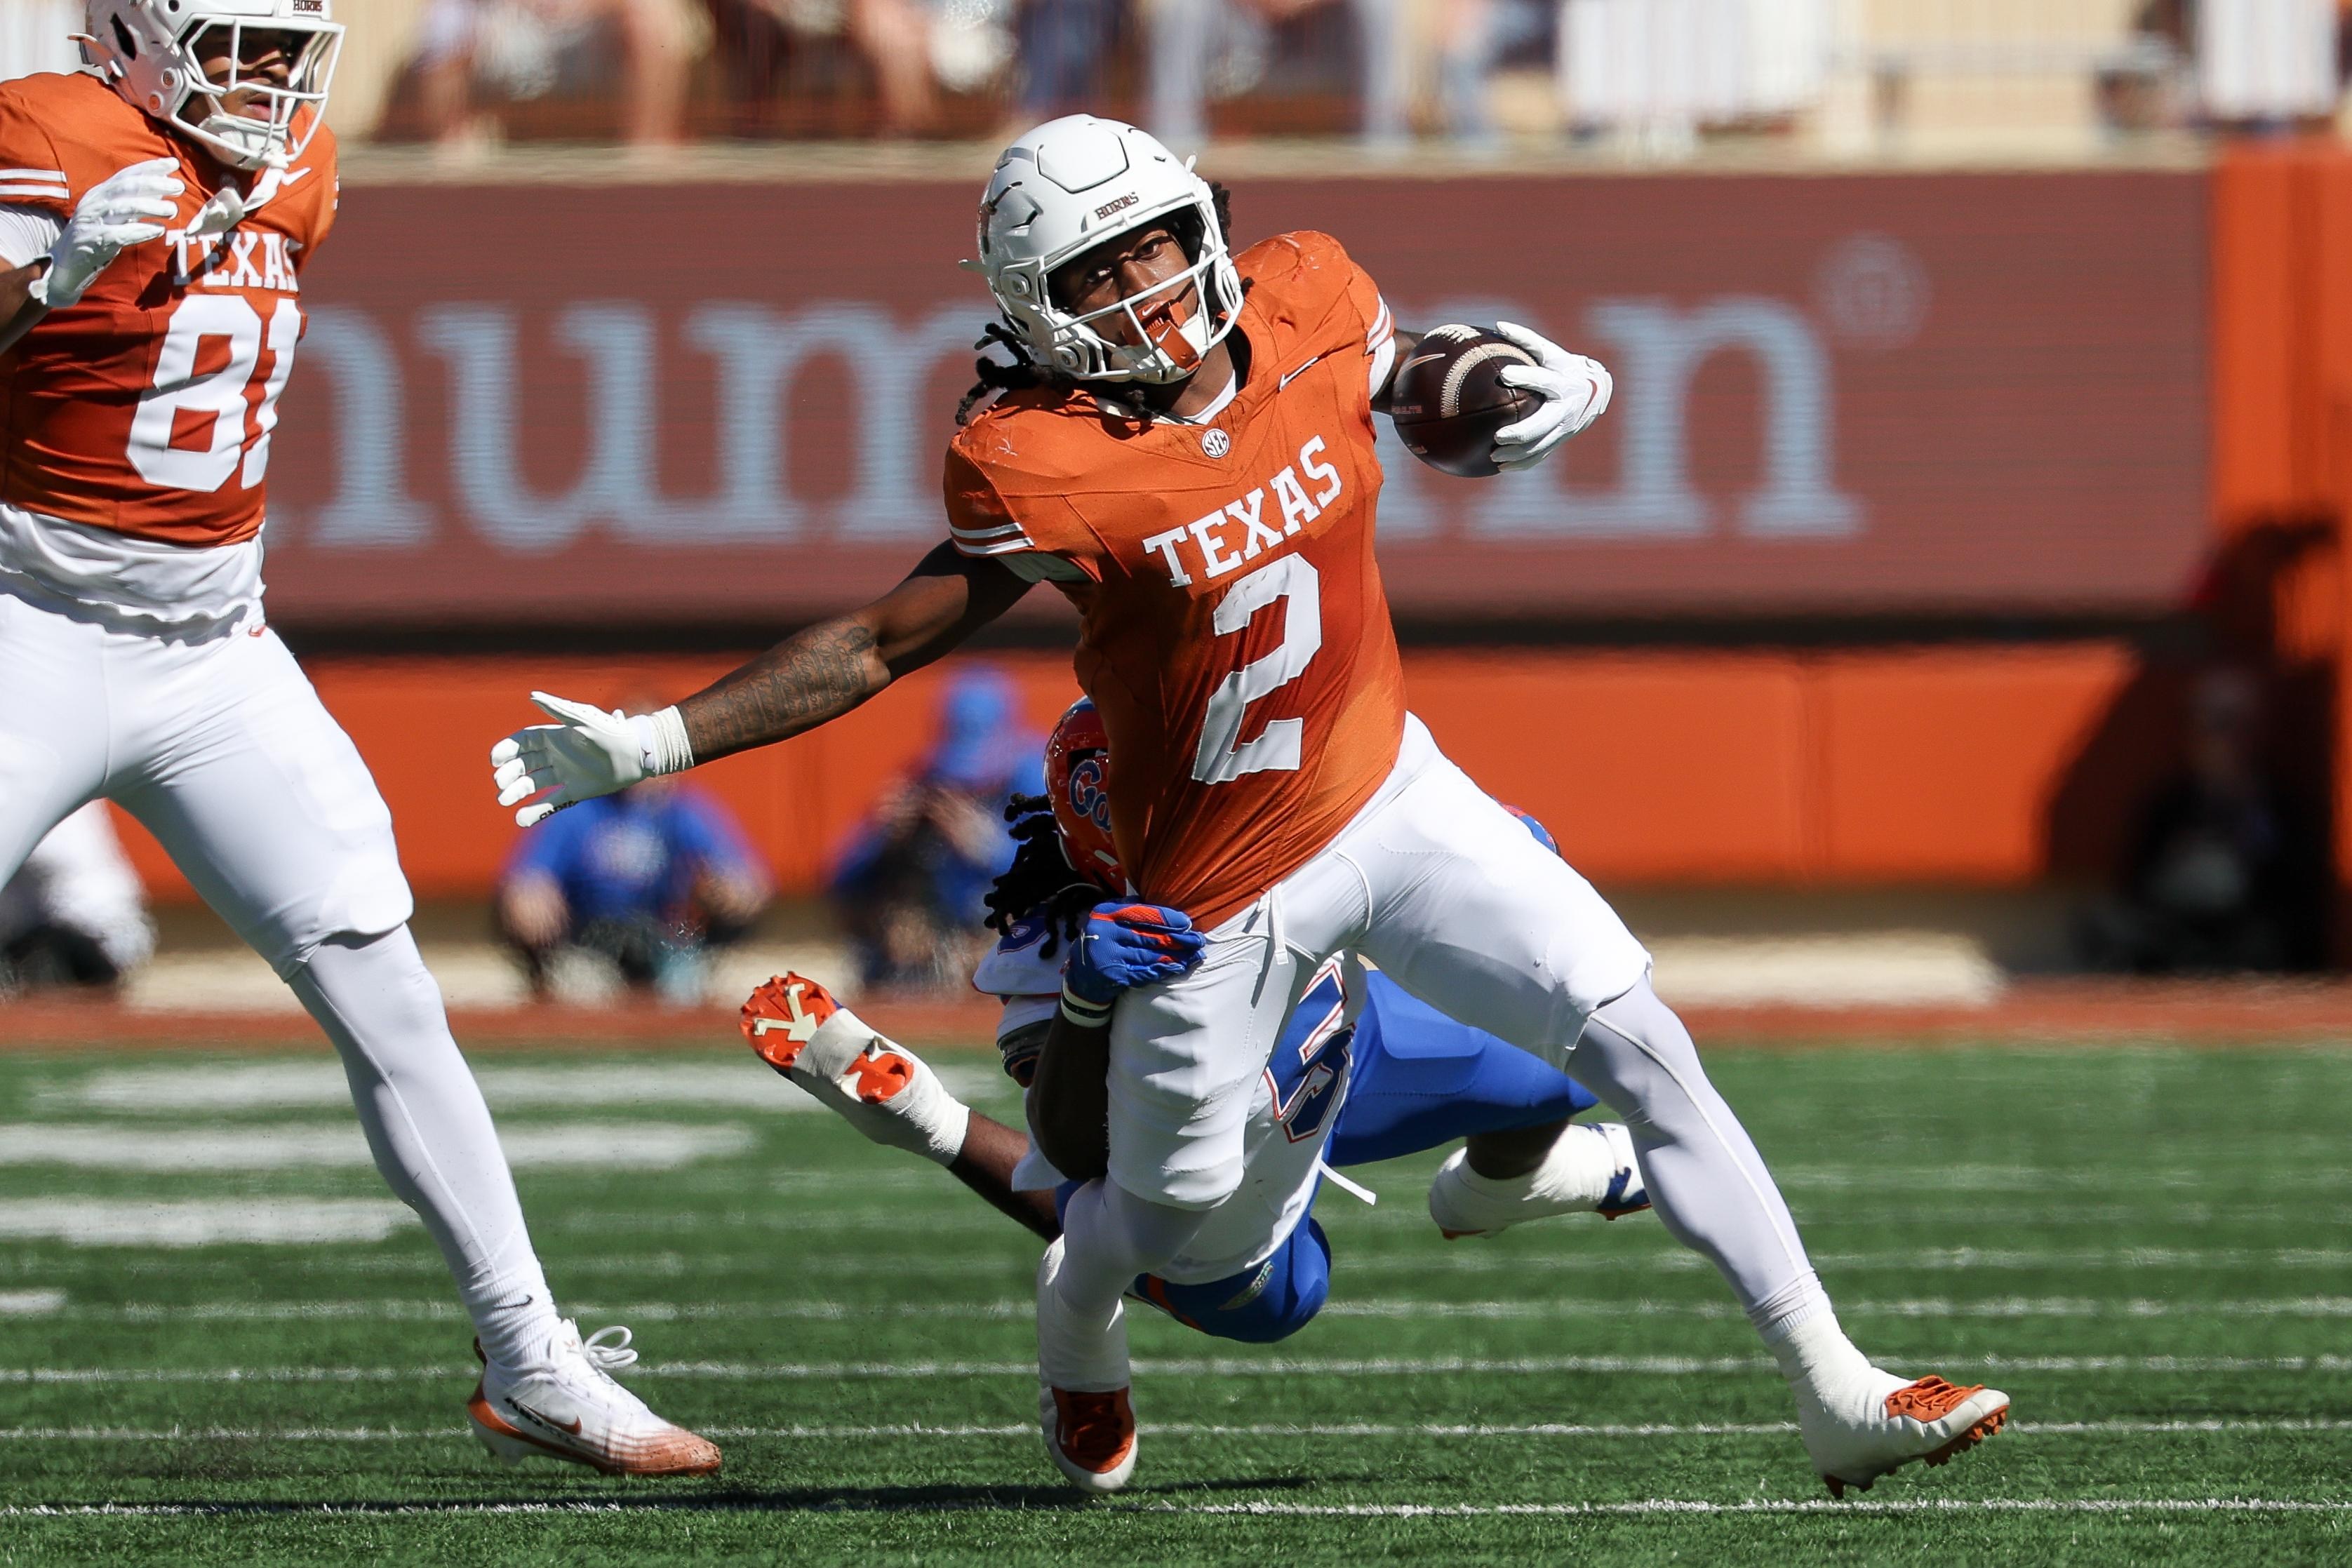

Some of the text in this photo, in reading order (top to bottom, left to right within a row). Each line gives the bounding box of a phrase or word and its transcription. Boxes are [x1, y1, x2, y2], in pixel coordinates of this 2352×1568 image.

[125, 294, 302, 492] 81
[1203, 429, 1229, 457] SEC
[1142, 434, 1343, 587] TEXAS
[1191, 551, 1322, 785] 2
